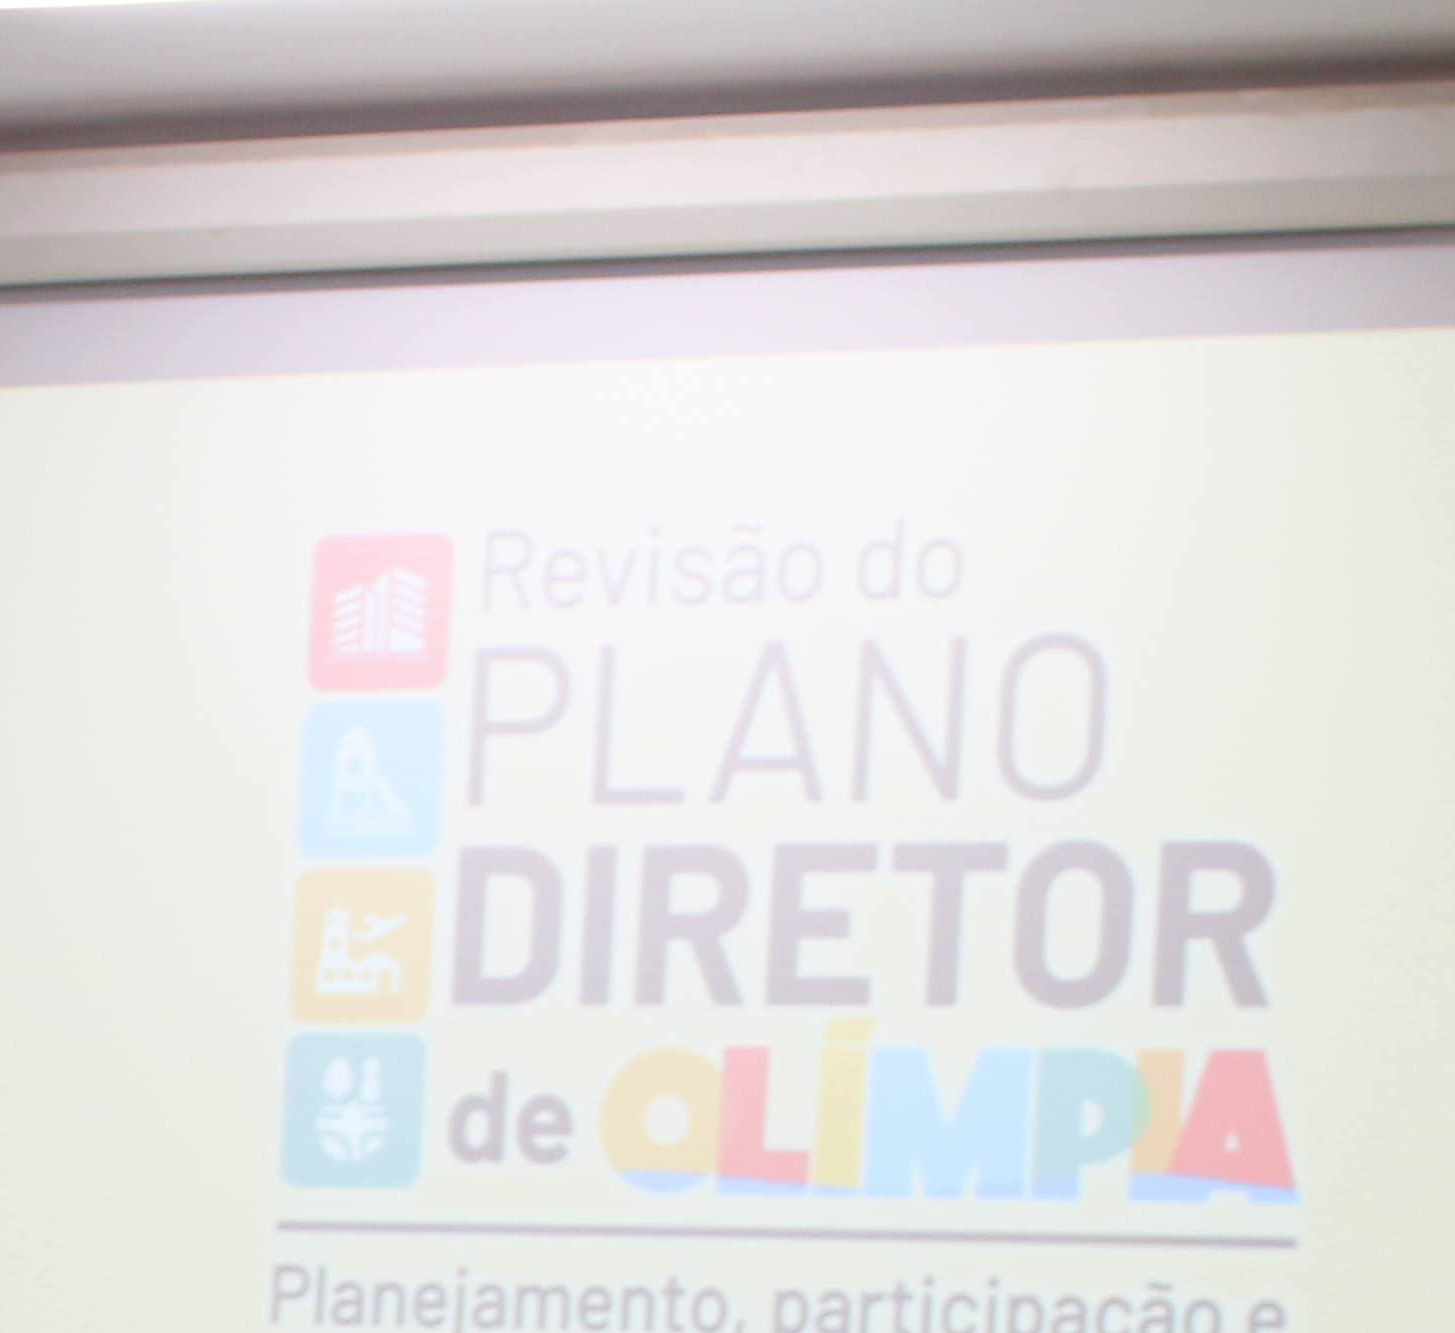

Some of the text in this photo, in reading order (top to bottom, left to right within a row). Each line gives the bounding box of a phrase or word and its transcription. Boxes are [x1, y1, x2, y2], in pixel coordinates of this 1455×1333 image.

[480, 519, 967, 609] Revisão do
[465, 631, 1109, 807] PLANO
[450, 837, 1278, 1010] DIRETOR
[448, 1016, 1301, 1203] de OLÍMPIA
